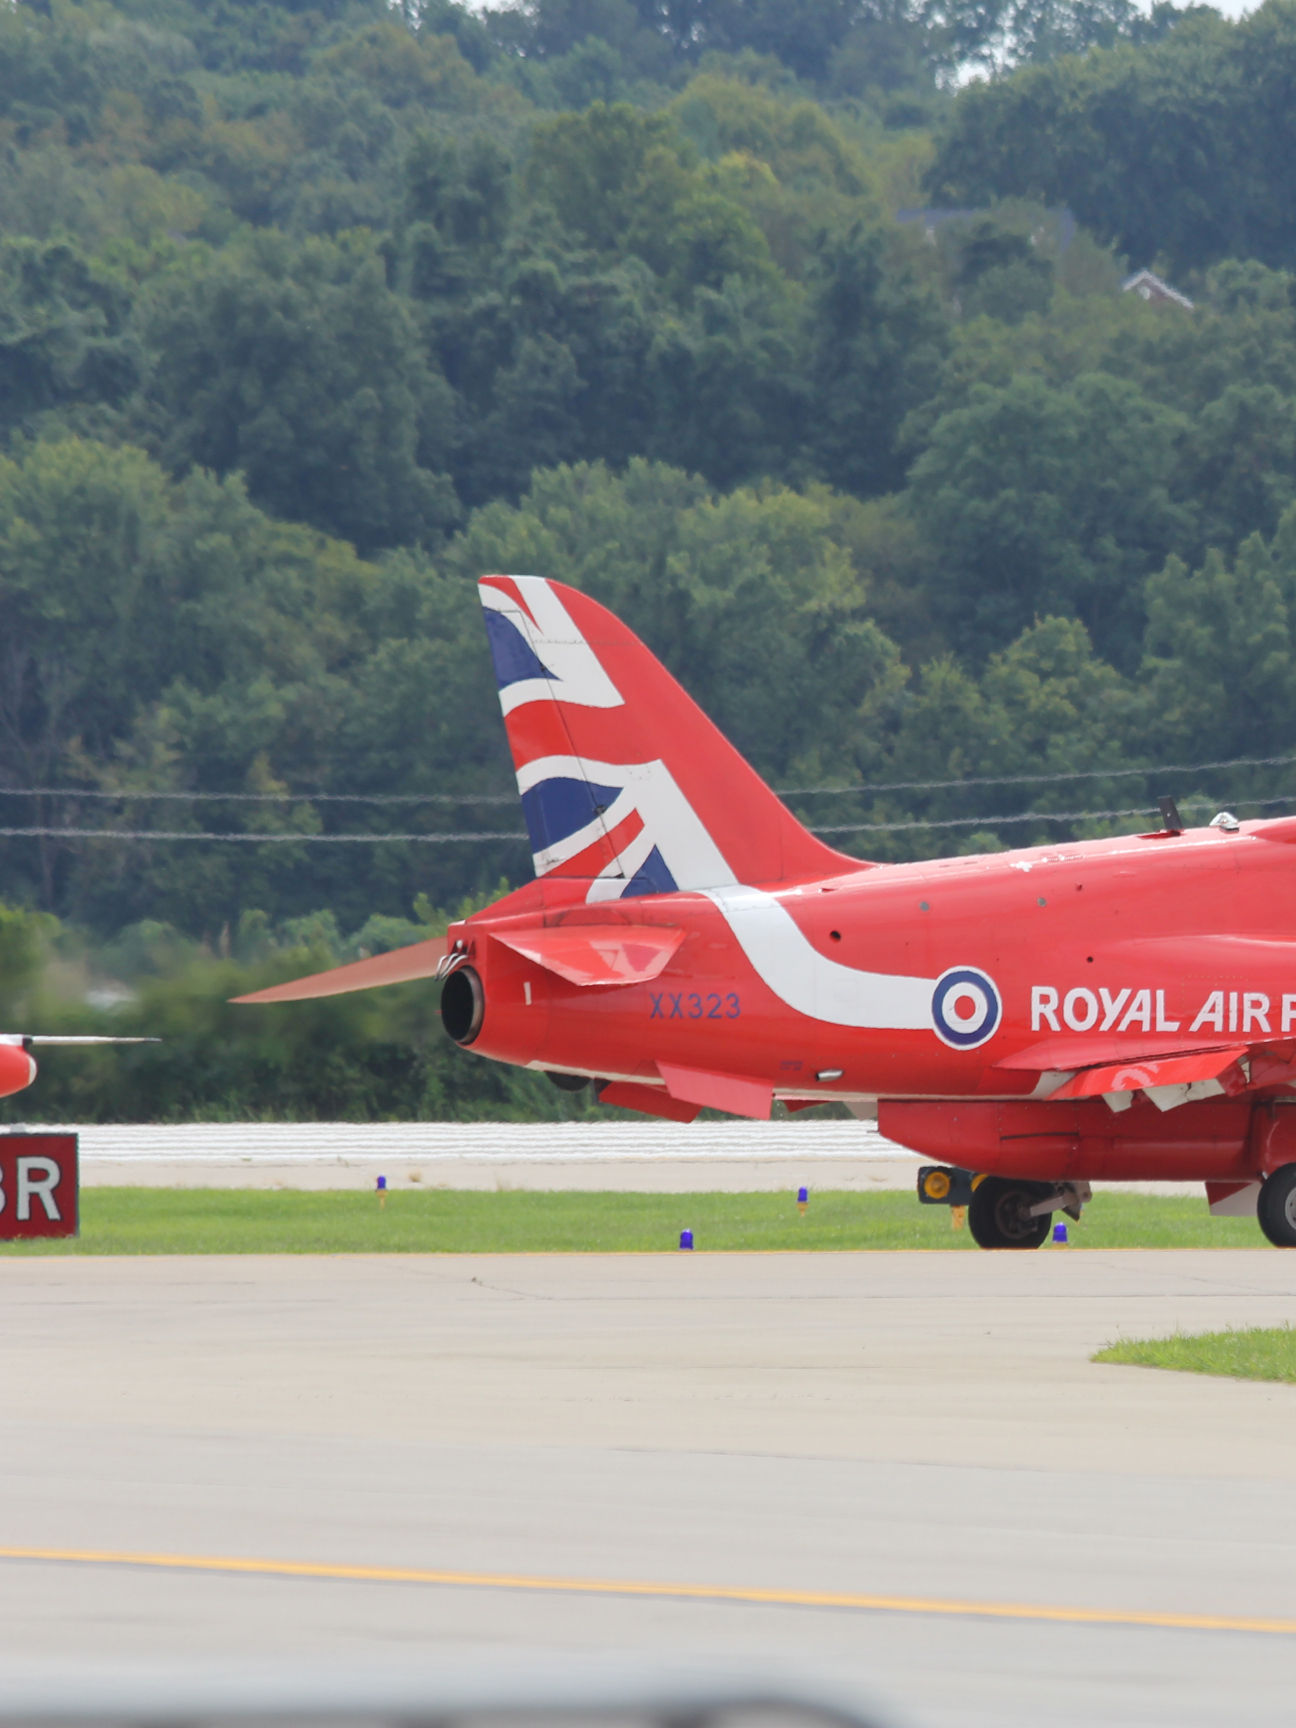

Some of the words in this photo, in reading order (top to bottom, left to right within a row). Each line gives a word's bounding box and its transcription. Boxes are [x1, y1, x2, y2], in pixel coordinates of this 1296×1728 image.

[649, 992, 741, 1019] XX323
[1031, 986, 1181, 1032] ROYAL
[1188, 990, 1272, 1033] AIR
[0, 1155, 62, 1221] R
